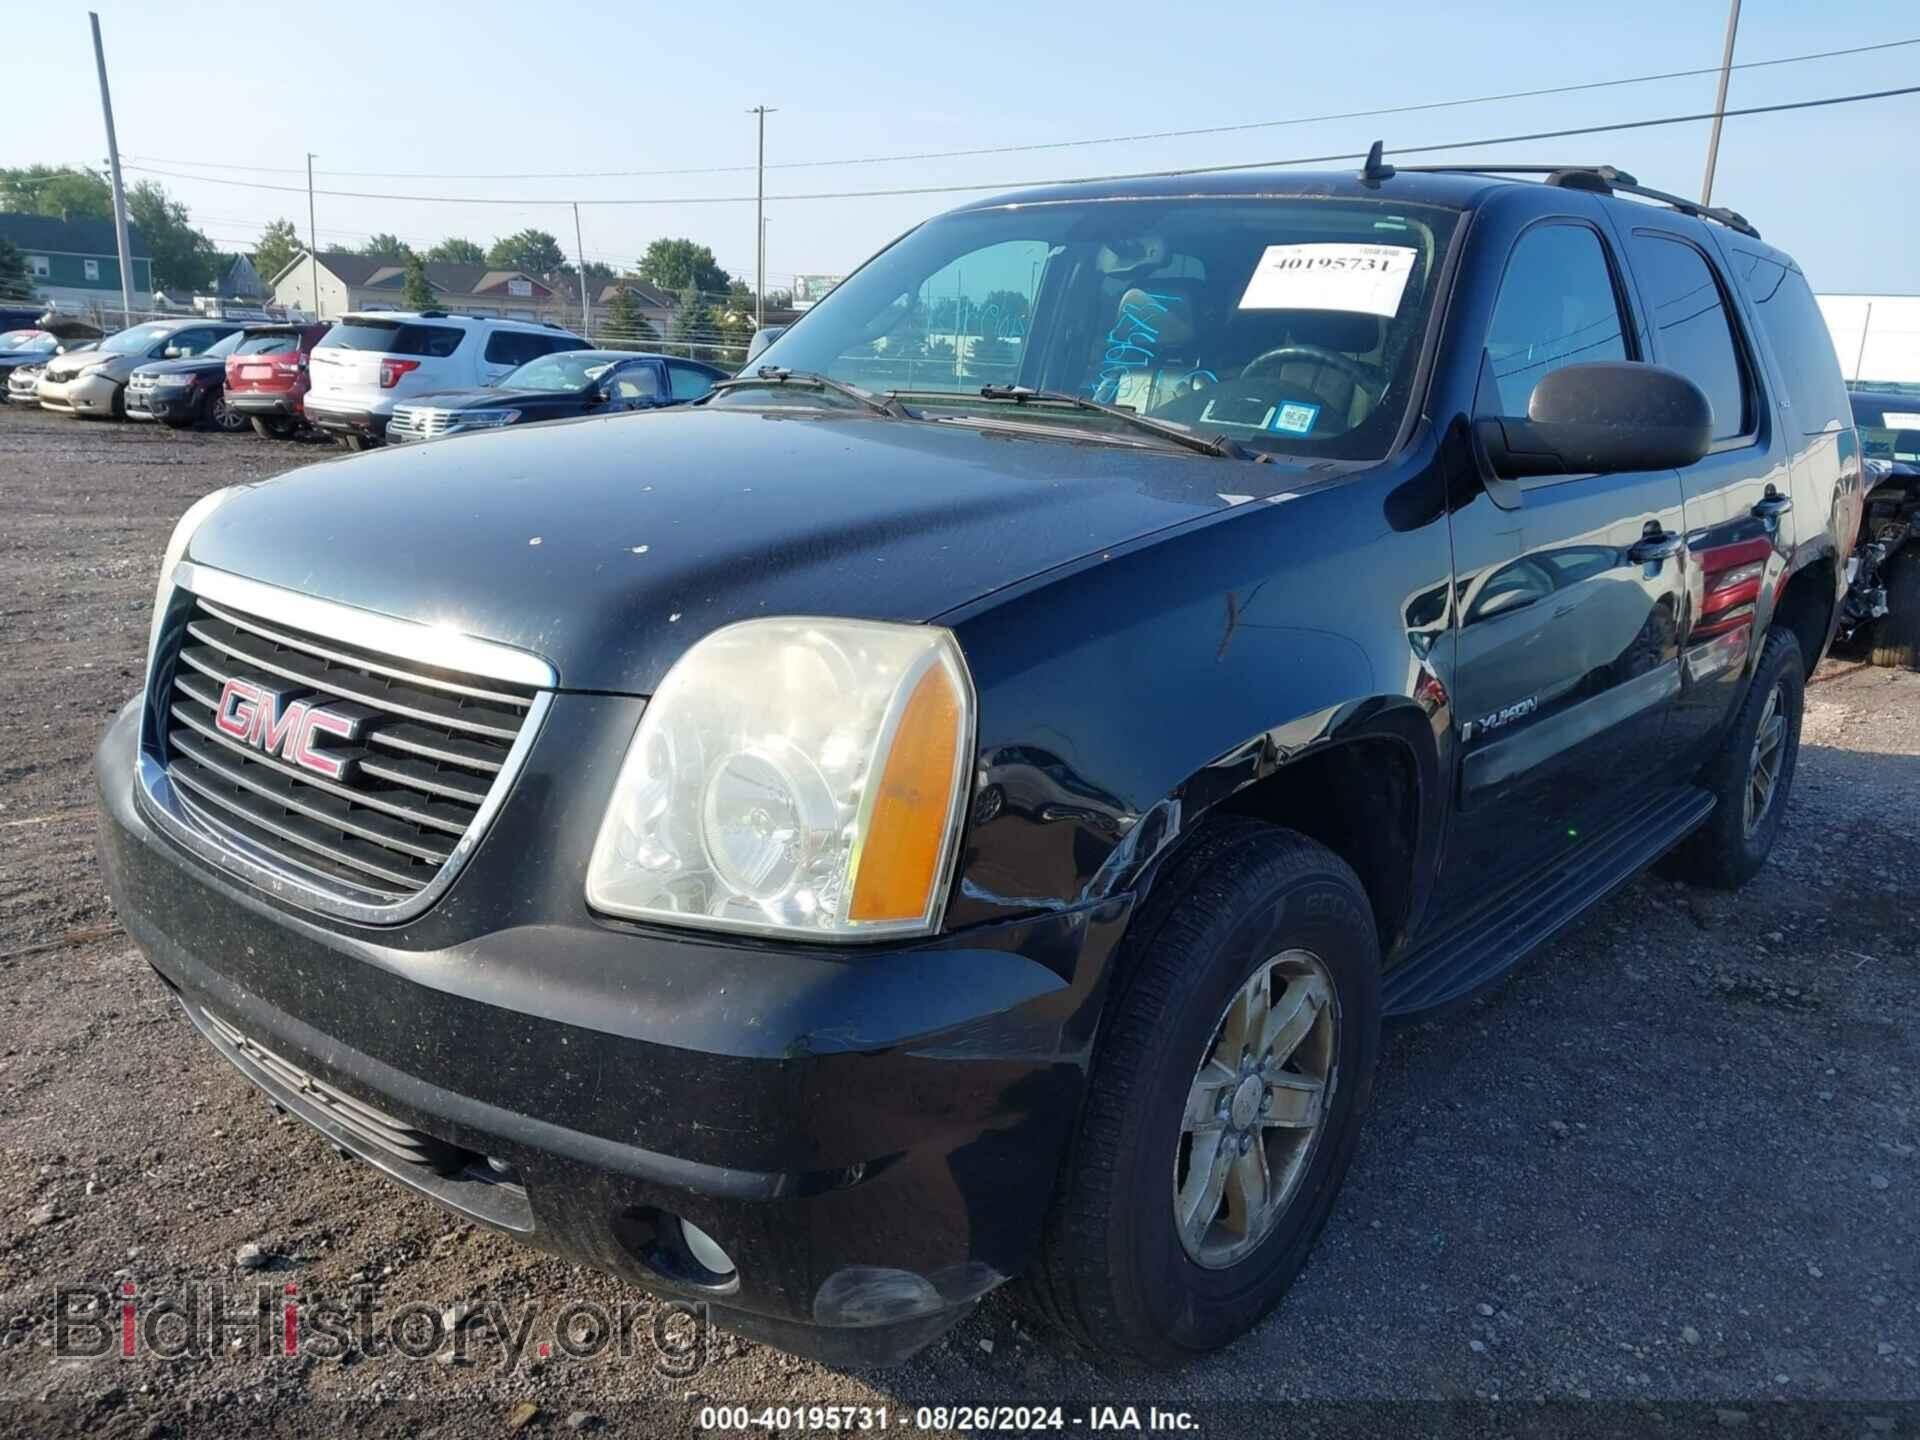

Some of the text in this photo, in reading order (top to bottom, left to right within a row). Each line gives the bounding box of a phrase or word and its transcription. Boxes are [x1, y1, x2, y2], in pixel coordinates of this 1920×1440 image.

[1272, 257, 1390, 272] 40195731
[215, 678, 356, 781] GMC
[1478, 695, 1539, 733] YUKON
